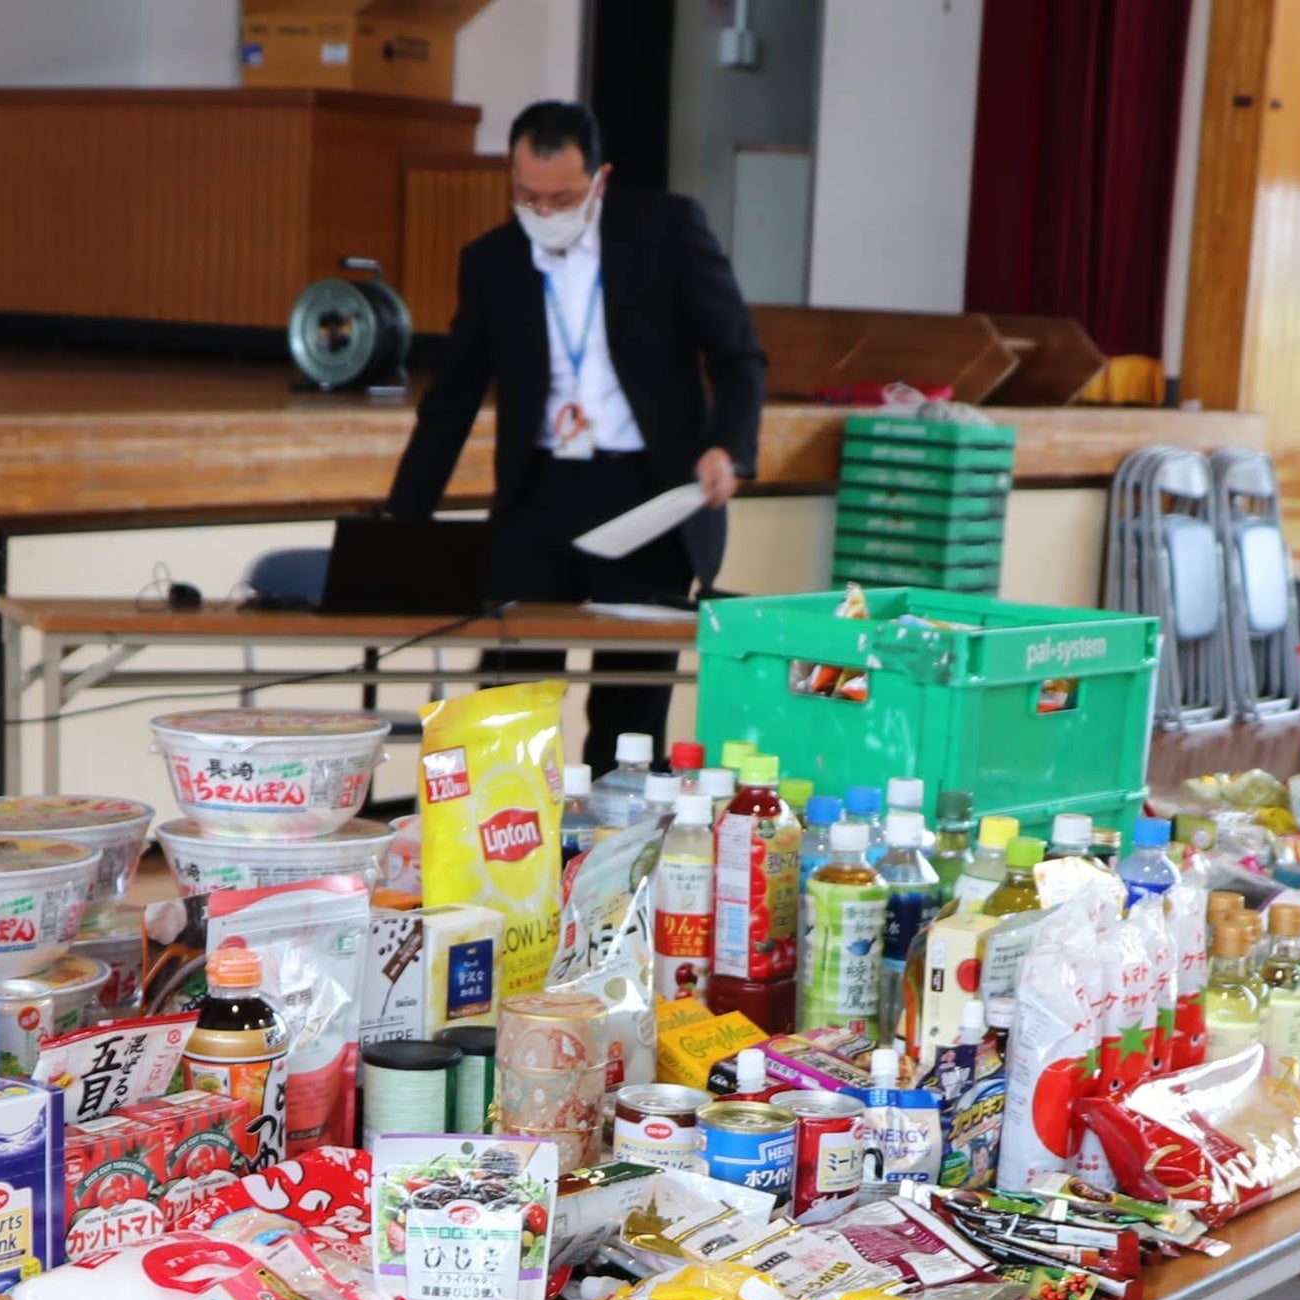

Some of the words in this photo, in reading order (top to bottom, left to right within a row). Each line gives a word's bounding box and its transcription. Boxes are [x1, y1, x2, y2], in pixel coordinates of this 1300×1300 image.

[206, 758, 254, 781] 長崎
[192, 771, 306, 805] ちゃんぽん
[482, 821, 539, 854] Lipton
[78, 1034, 124, 1117] 五目
[863, 1127, 929, 1144] ENERGY
[745, 1167, 793, 1188] ホワイト
[67, 1213, 166, 1254] カットトマト
